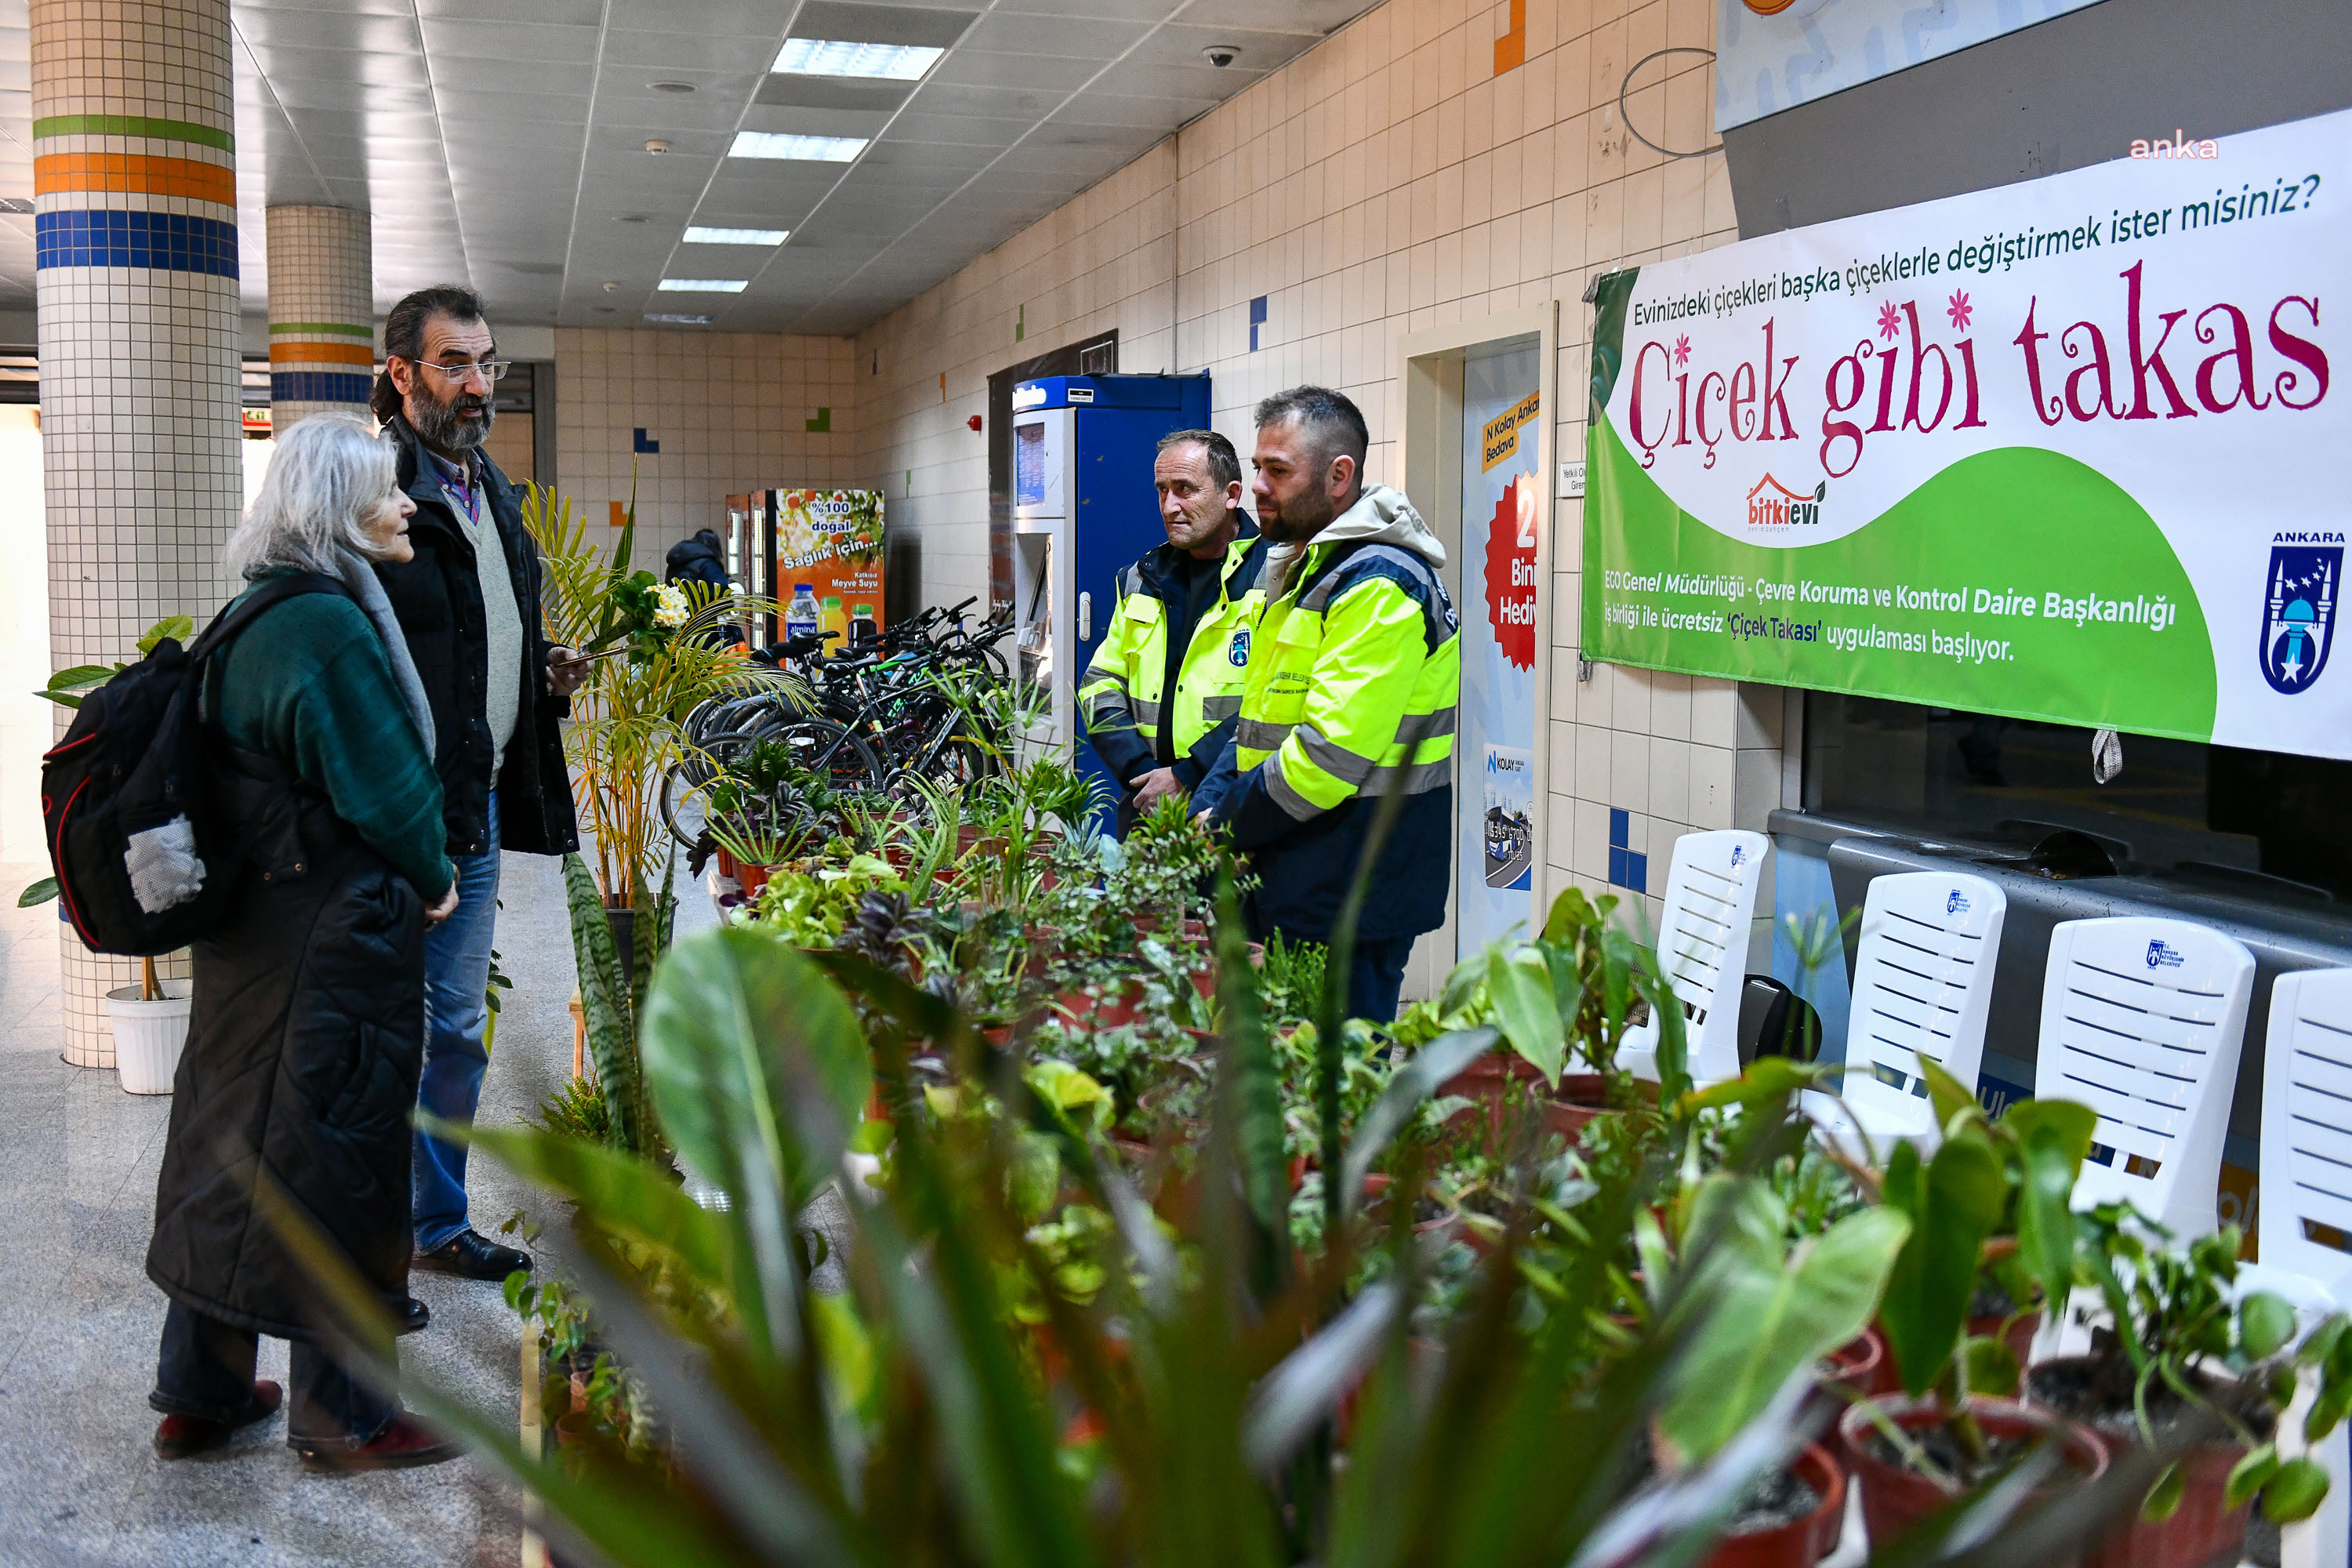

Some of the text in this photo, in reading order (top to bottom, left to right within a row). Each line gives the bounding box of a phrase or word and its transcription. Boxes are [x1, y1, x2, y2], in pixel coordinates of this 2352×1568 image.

[1635, 173, 2321, 325] Evinizdeki çiçekleri başka çiçeklerle değiştirmek ister misiniz?
[1629, 259, 2329, 478] Çiçek gibi takas
[1487, 426, 1493, 442] N
[1495, 414, 1515, 437] Kolay
[1486, 436, 1514, 463] Bedava
[811, 503, 849, 514] %100
[1517, 488, 1535, 547] 2
[1748, 496, 1819, 524] bitkievi
[812, 521, 850, 534] doğal
[2273, 532, 2345, 543] ANKARA
[784, 539, 878, 570] Sağlık için...
[832, 579, 878, 589] Meyve Suyu
[1605, 571, 1621, 590] EGO
[1623, 572, 1662, 592] Genel
[1664, 573, 1744, 602] Müdürlüğü
[1755, 578, 1795, 605] Çevre
[1800, 580, 1869, 606] Koruma
[1873, 588, 1892, 608] ve
[1896, 585, 1968, 612] Kontrol
[1973, 588, 2037, 616] Daire
[2043, 592, 2176, 631] Başkanlığı
[1605, 602, 1612, 627] iş
[1613, 603, 1639, 630] birliği
[1642, 604, 1658, 626] ile
[1661, 608, 1723, 633] ücretsiz
[1827, 623, 1926, 652] uygulaması
[1932, 630, 2014, 664] başlıyor.
[1497, 757, 1515, 771] KOLAY
